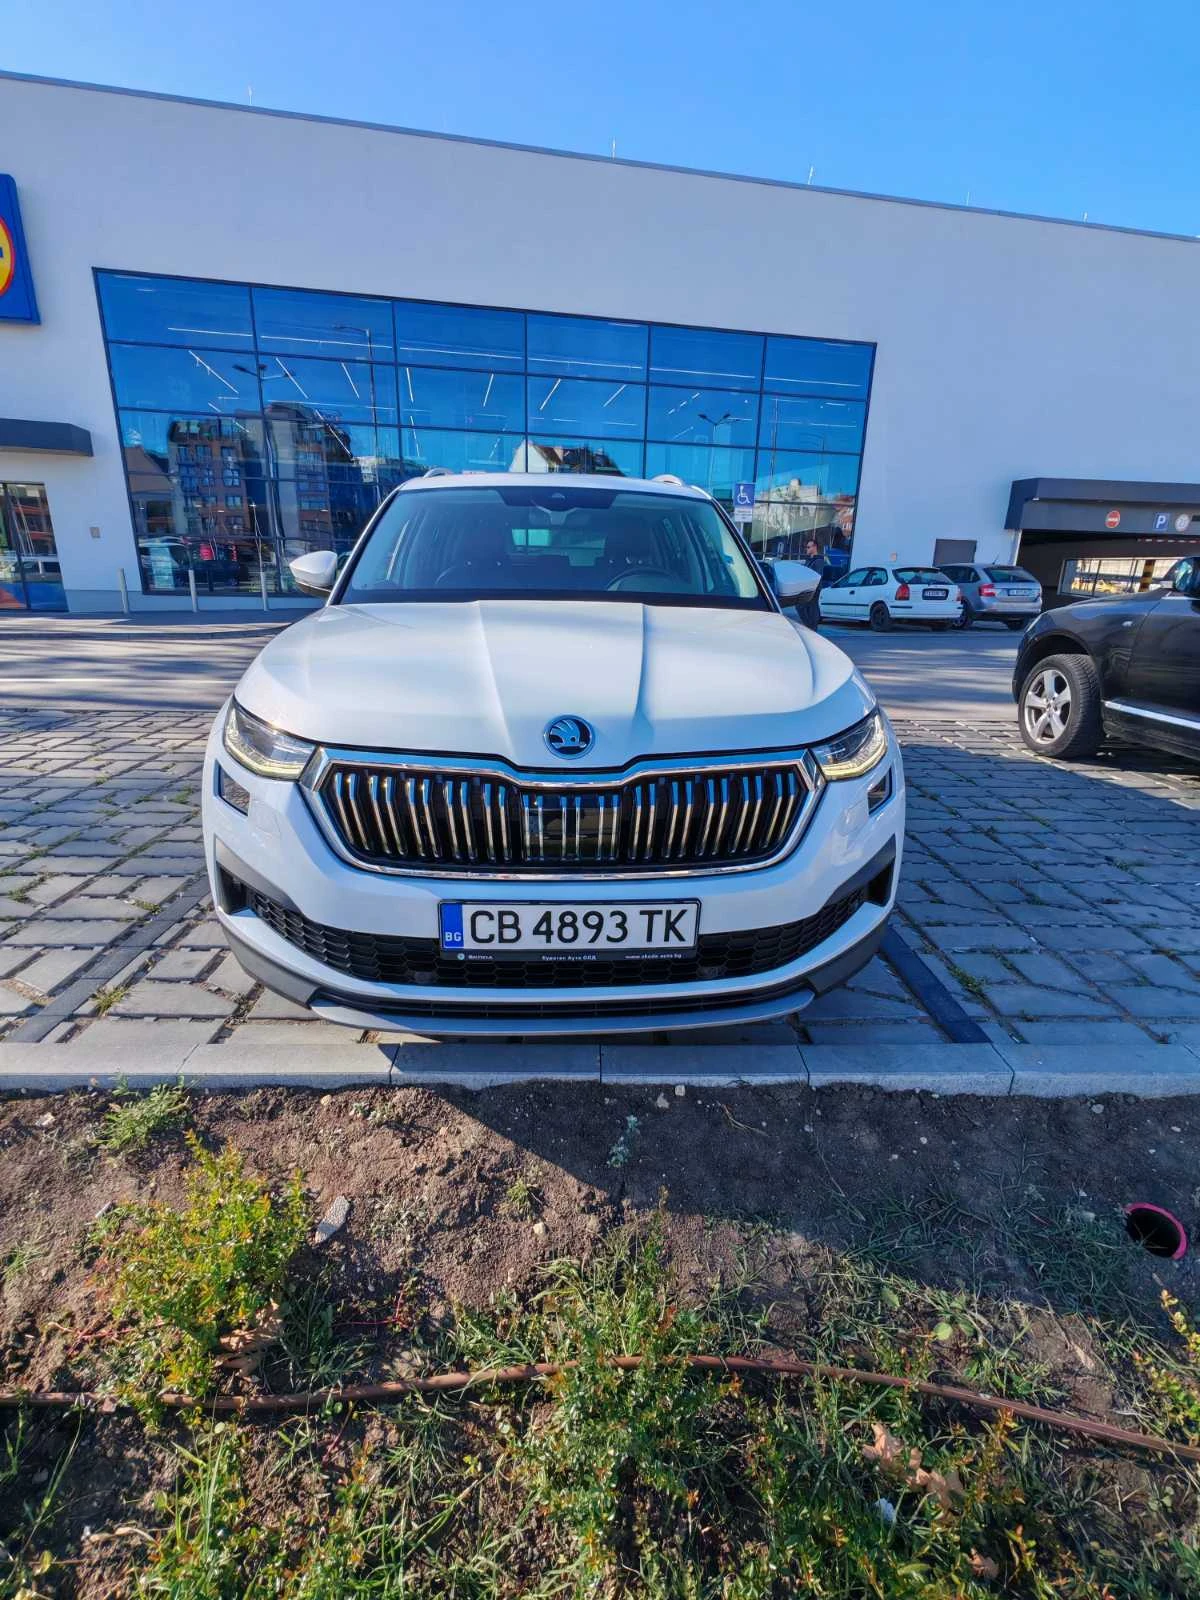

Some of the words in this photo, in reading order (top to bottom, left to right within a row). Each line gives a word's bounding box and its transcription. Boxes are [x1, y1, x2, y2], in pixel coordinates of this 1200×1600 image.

[1155, 515, 1167, 529] P
[470, 910, 521, 944] CB
[532, 910, 629, 944] 4893
[640, 909, 688, 943] TK
[445, 932, 462, 942] BG
